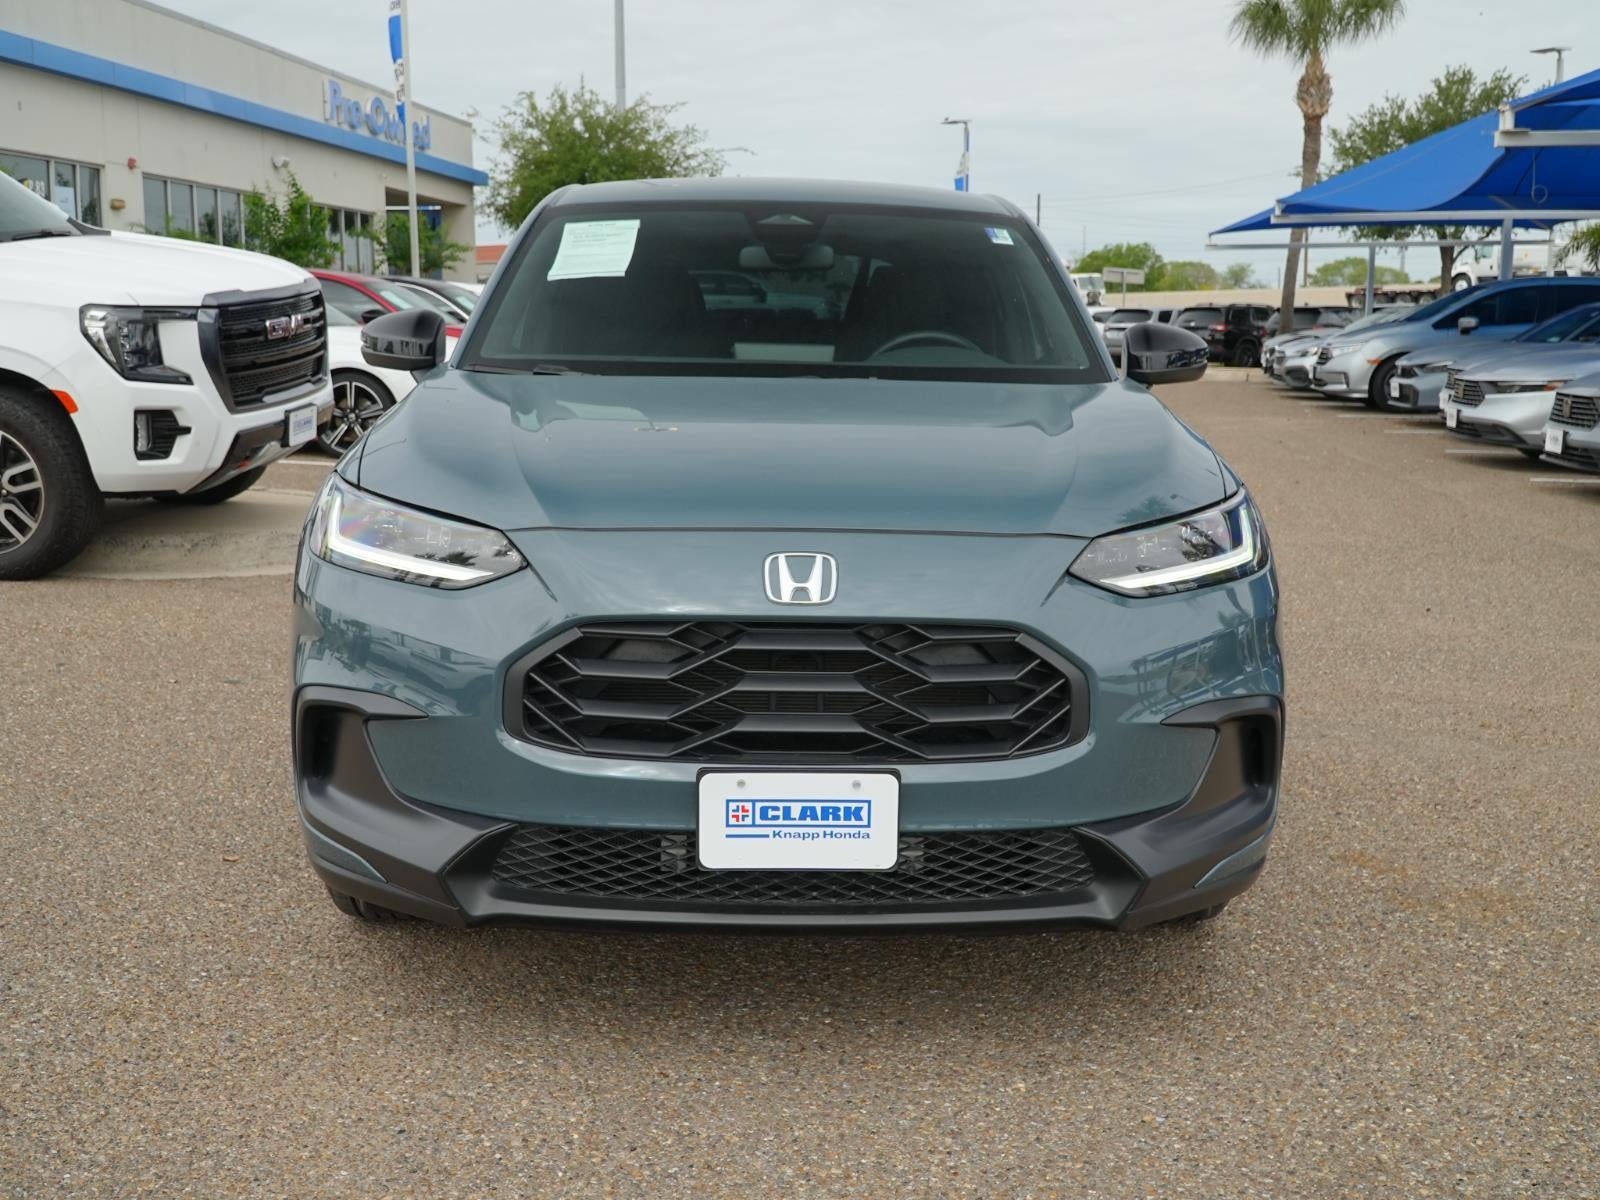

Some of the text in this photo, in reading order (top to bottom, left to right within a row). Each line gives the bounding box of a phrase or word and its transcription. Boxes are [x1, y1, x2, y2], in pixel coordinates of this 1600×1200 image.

[322, 79, 432, 151] Pre-Owed
[266, 314, 313, 340] GMC
[759, 805, 865, 822] CLARK
[772, 830, 871, 841] Knapp Honda
